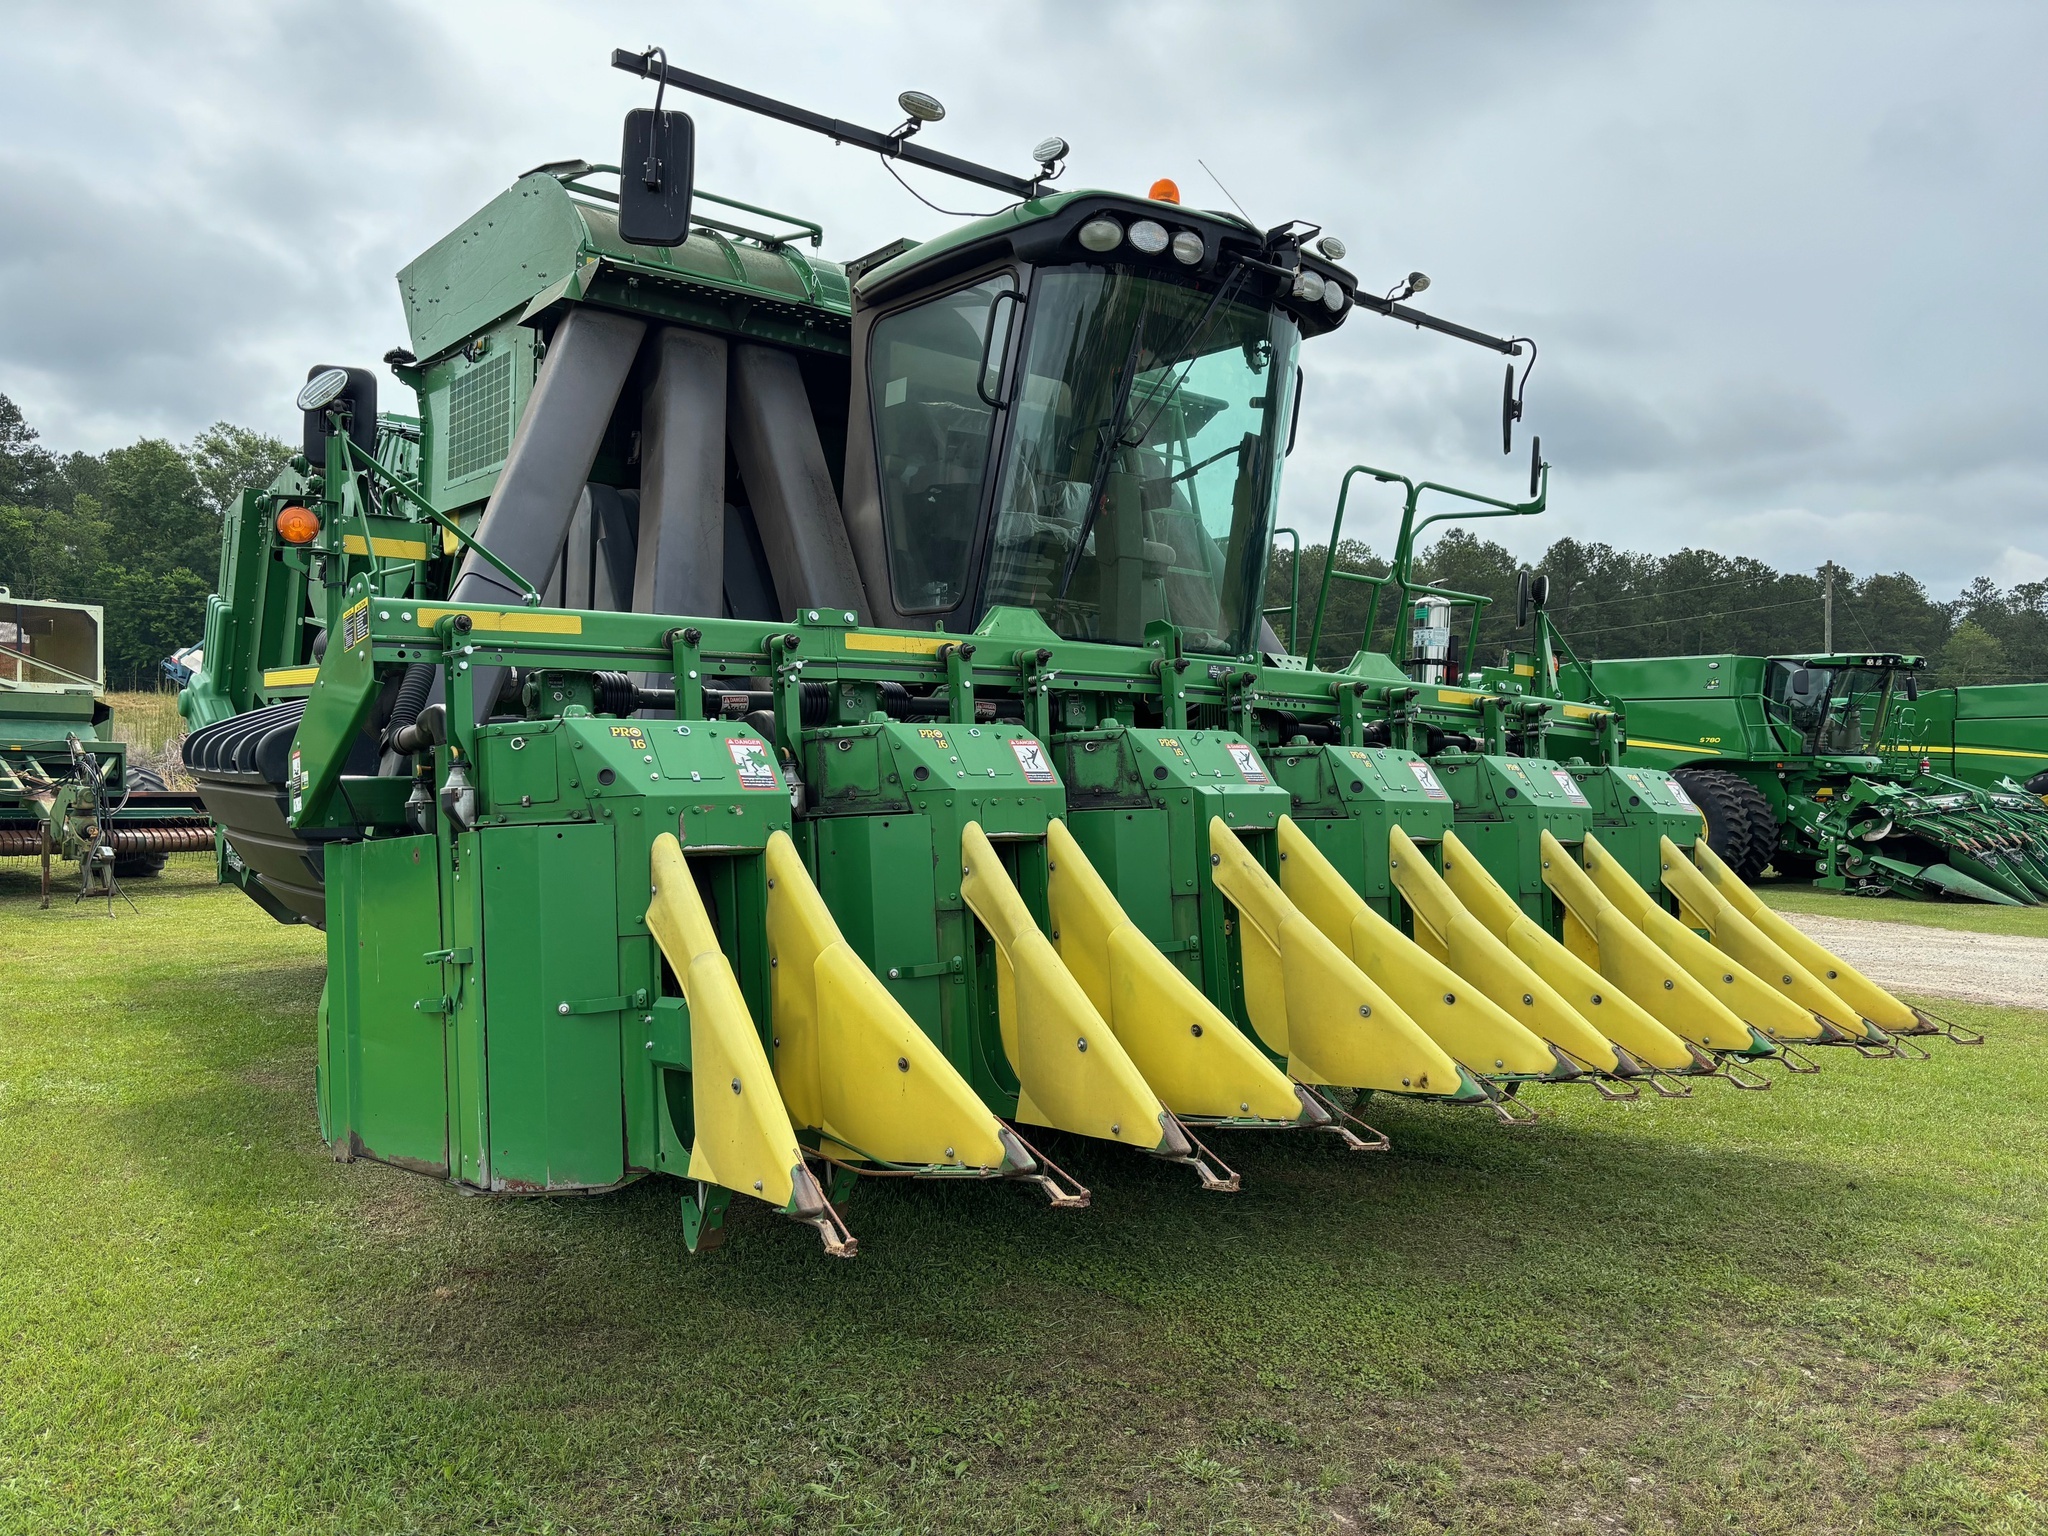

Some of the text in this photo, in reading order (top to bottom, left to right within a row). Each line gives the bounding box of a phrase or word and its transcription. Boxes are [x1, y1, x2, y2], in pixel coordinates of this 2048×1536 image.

[610, 726, 642, 737] PRO
[918, 729, 943, 739] PRO
[630, 739, 646, 749] 16
[935, 739, 948, 749] 16
[1157, 738, 1178, 747] PRO
[1172, 747, 1184, 757] 16
